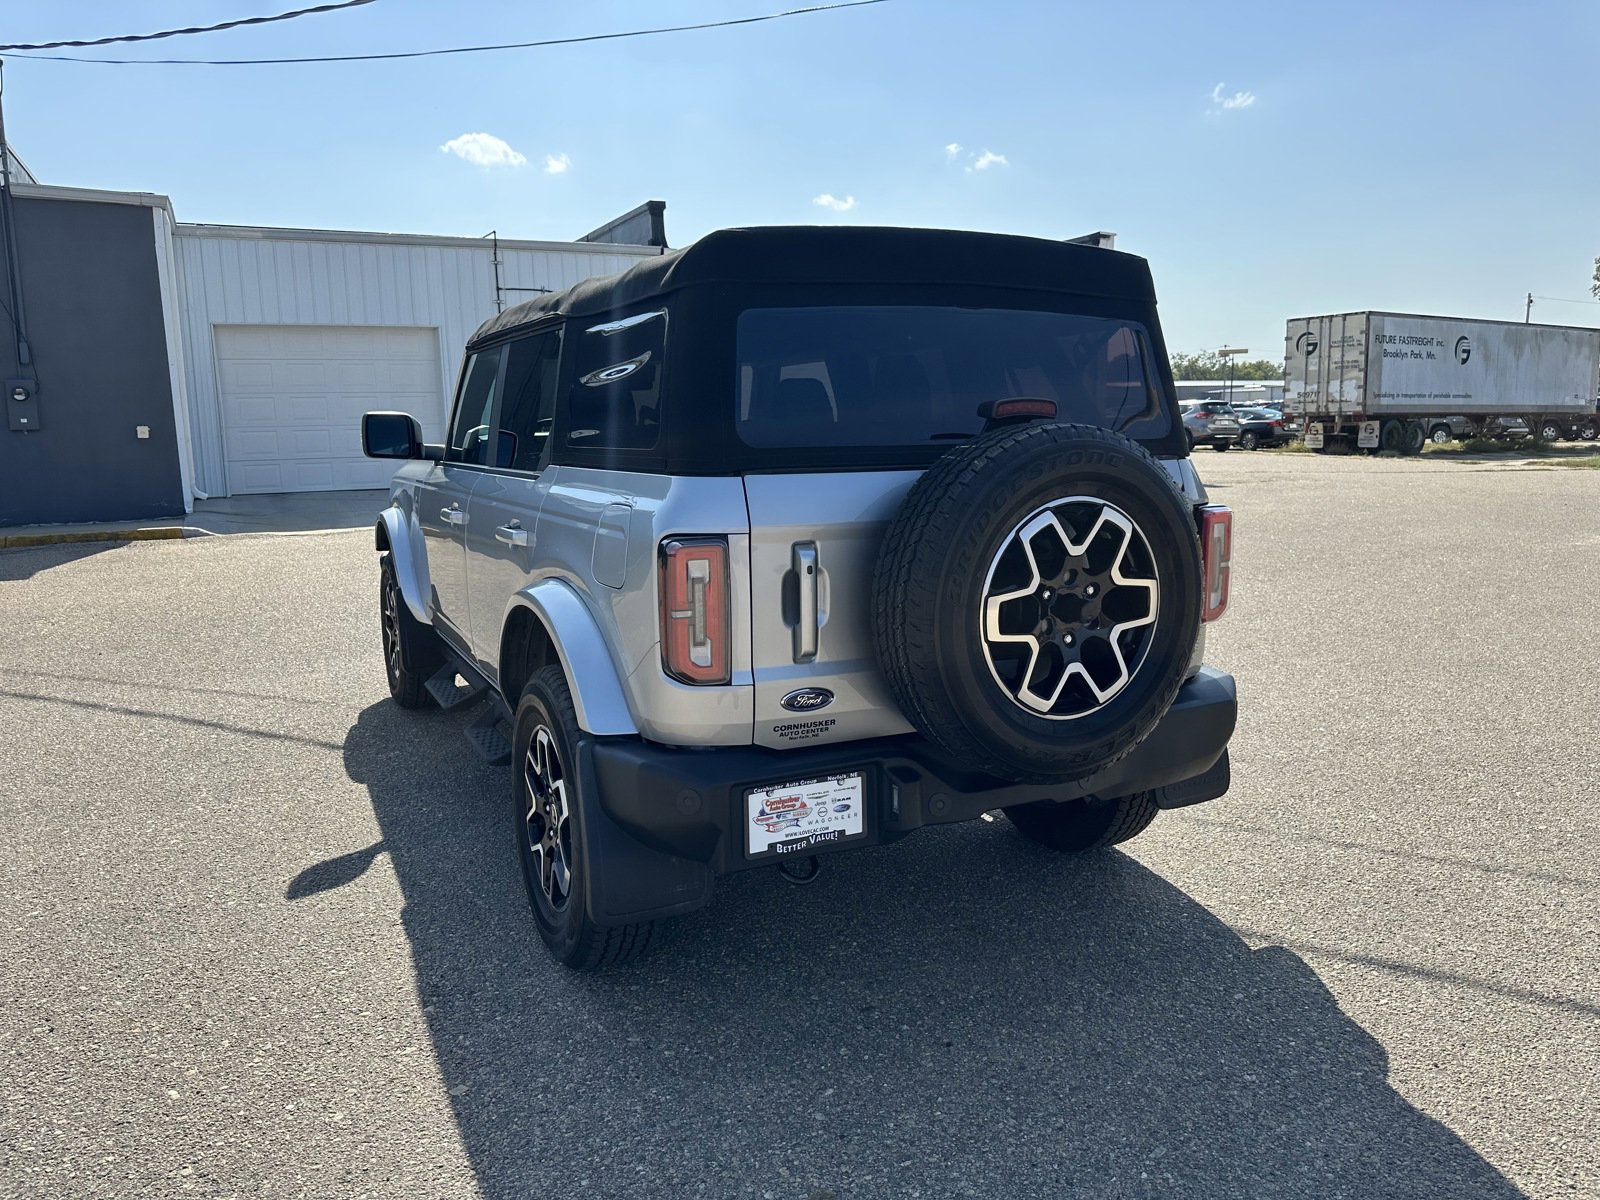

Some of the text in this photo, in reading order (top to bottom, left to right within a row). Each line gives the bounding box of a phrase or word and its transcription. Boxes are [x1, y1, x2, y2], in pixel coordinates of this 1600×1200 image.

[1374, 334, 1397, 344] FUTURE
[1398, 335, 1435, 347] FASTFREIGHT
[1383, 348, 1409, 361] Brooklyn
[1410, 350, 1424, 360] Park,
[794, 694, 823, 707] Ford
[773, 718, 837, 733] CORNHUSKER
[778, 727, 830, 738] AUTO CENTER
[753, 783, 784, 794] Cornhusker
[785, 780, 799, 788] Auto
[800, 778, 817, 787] Group
[827, 774, 848, 782] Norfolk,
[807, 813, 859, 826] WAGONEER
